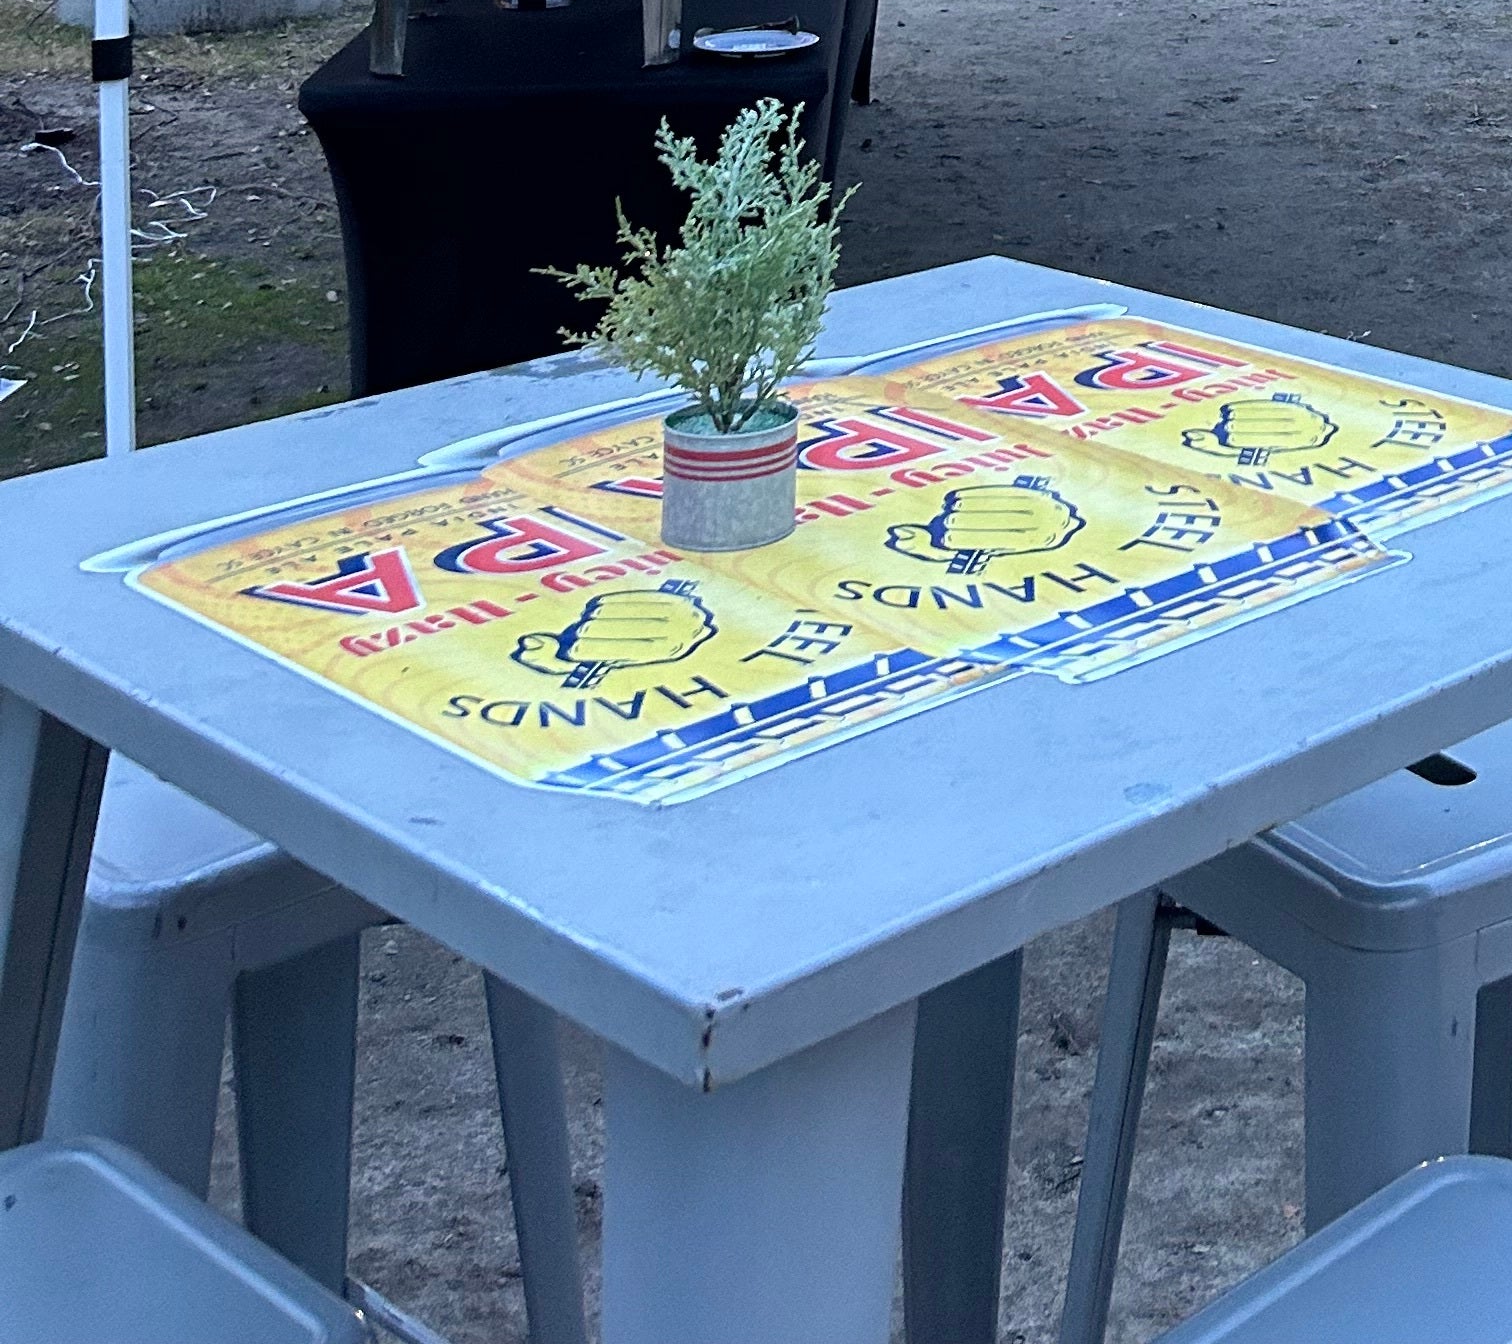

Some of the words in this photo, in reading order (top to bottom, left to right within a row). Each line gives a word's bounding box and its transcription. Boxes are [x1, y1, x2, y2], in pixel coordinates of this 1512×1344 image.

[953, 339, 1254, 419] IPA
[1062, 406, 1164, 440] Haz
[1371, 398, 1447, 449] STEEL
[1204, 456, 1377, 491] HAN
[1118, 484, 1221, 552] STEEL
[833, 562, 1121, 611] HANDS
[739, 608, 854, 666] EEL
[442, 674, 731, 730] HANDS
